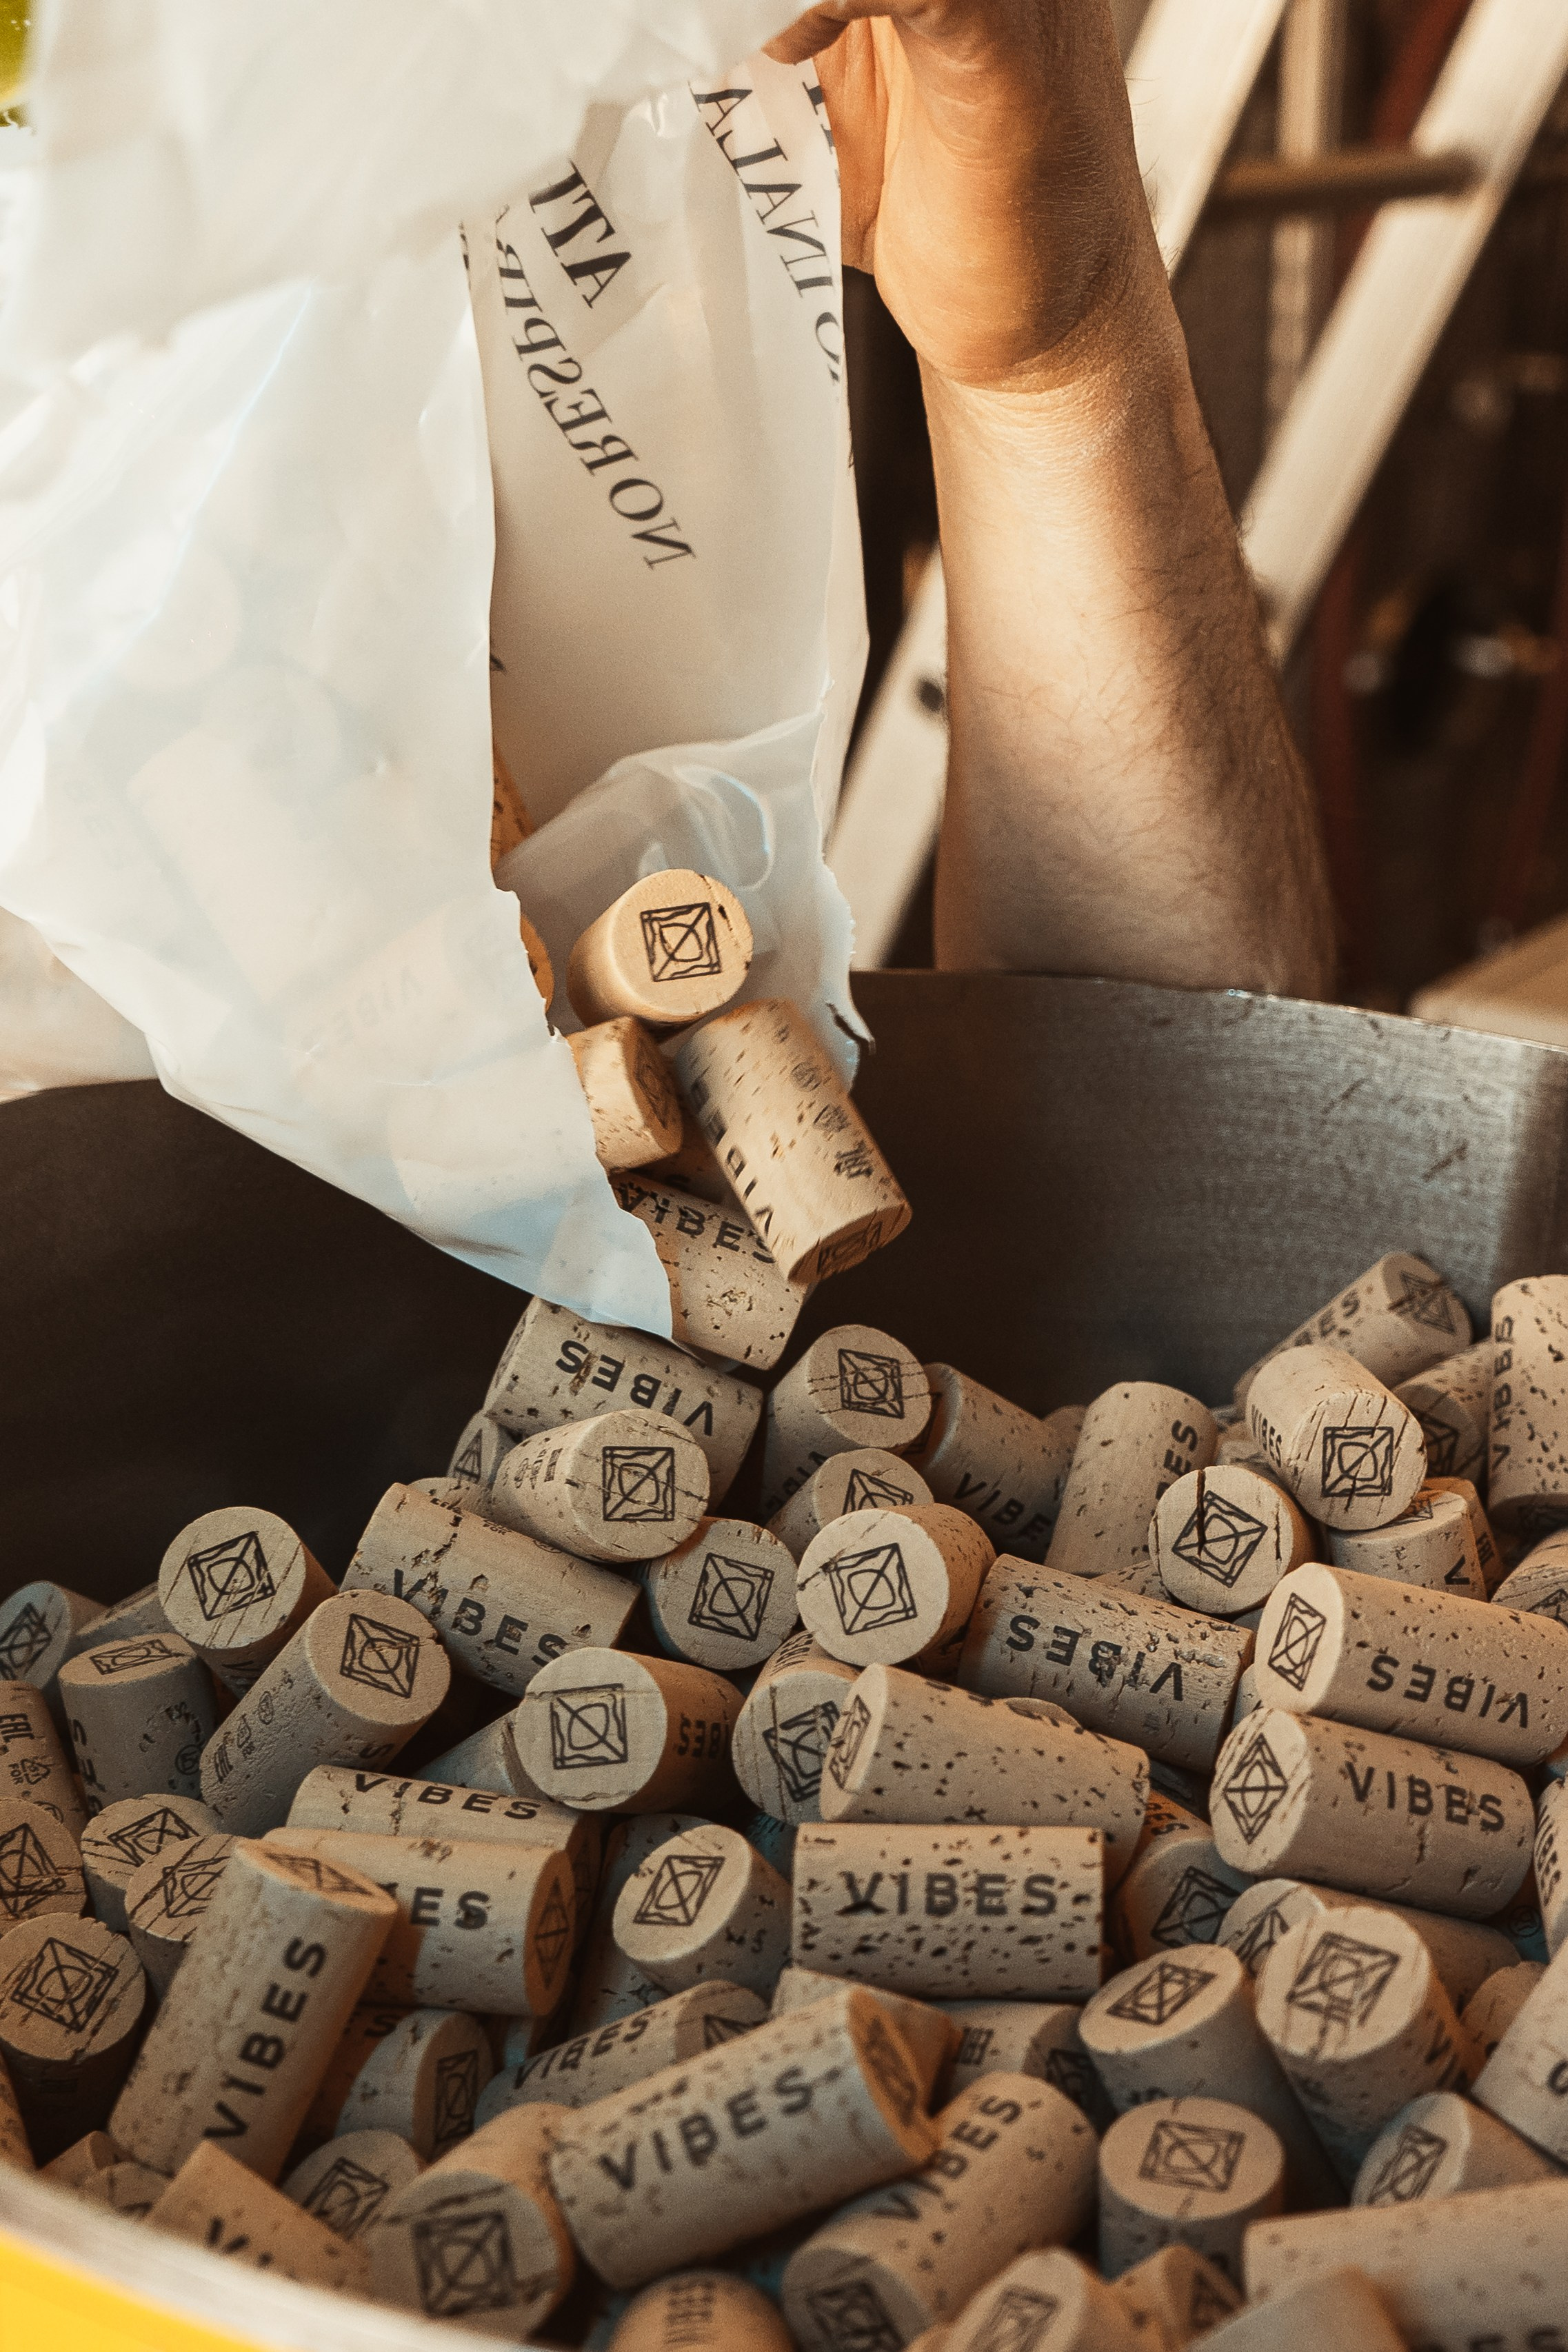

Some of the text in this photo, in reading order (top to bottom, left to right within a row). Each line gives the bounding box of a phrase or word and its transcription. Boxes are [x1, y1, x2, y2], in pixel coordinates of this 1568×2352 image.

[556, 1340, 713, 1436] VIBES
[1492, 1316, 1515, 1470] VIBES
[1251, 1404, 1283, 1467] VIBES
[954, 1471, 1052, 1542] VIBE
[394, 1569, 570, 1666] VIBES
[1006, 1614, 1184, 1701] VIBES
[1367, 1653, 1529, 1728] VIBES
[355, 1773, 541, 1820] VIBES
[1345, 1761, 1505, 1832] VIBES
[843, 1871, 1058, 1917] VIBES
[205, 1936, 327, 2138] VIBES
[512, 2008, 655, 2090] VIBES
[599, 2064, 815, 2191] VIBES
[870, 2094, 1023, 2221] VIBES
